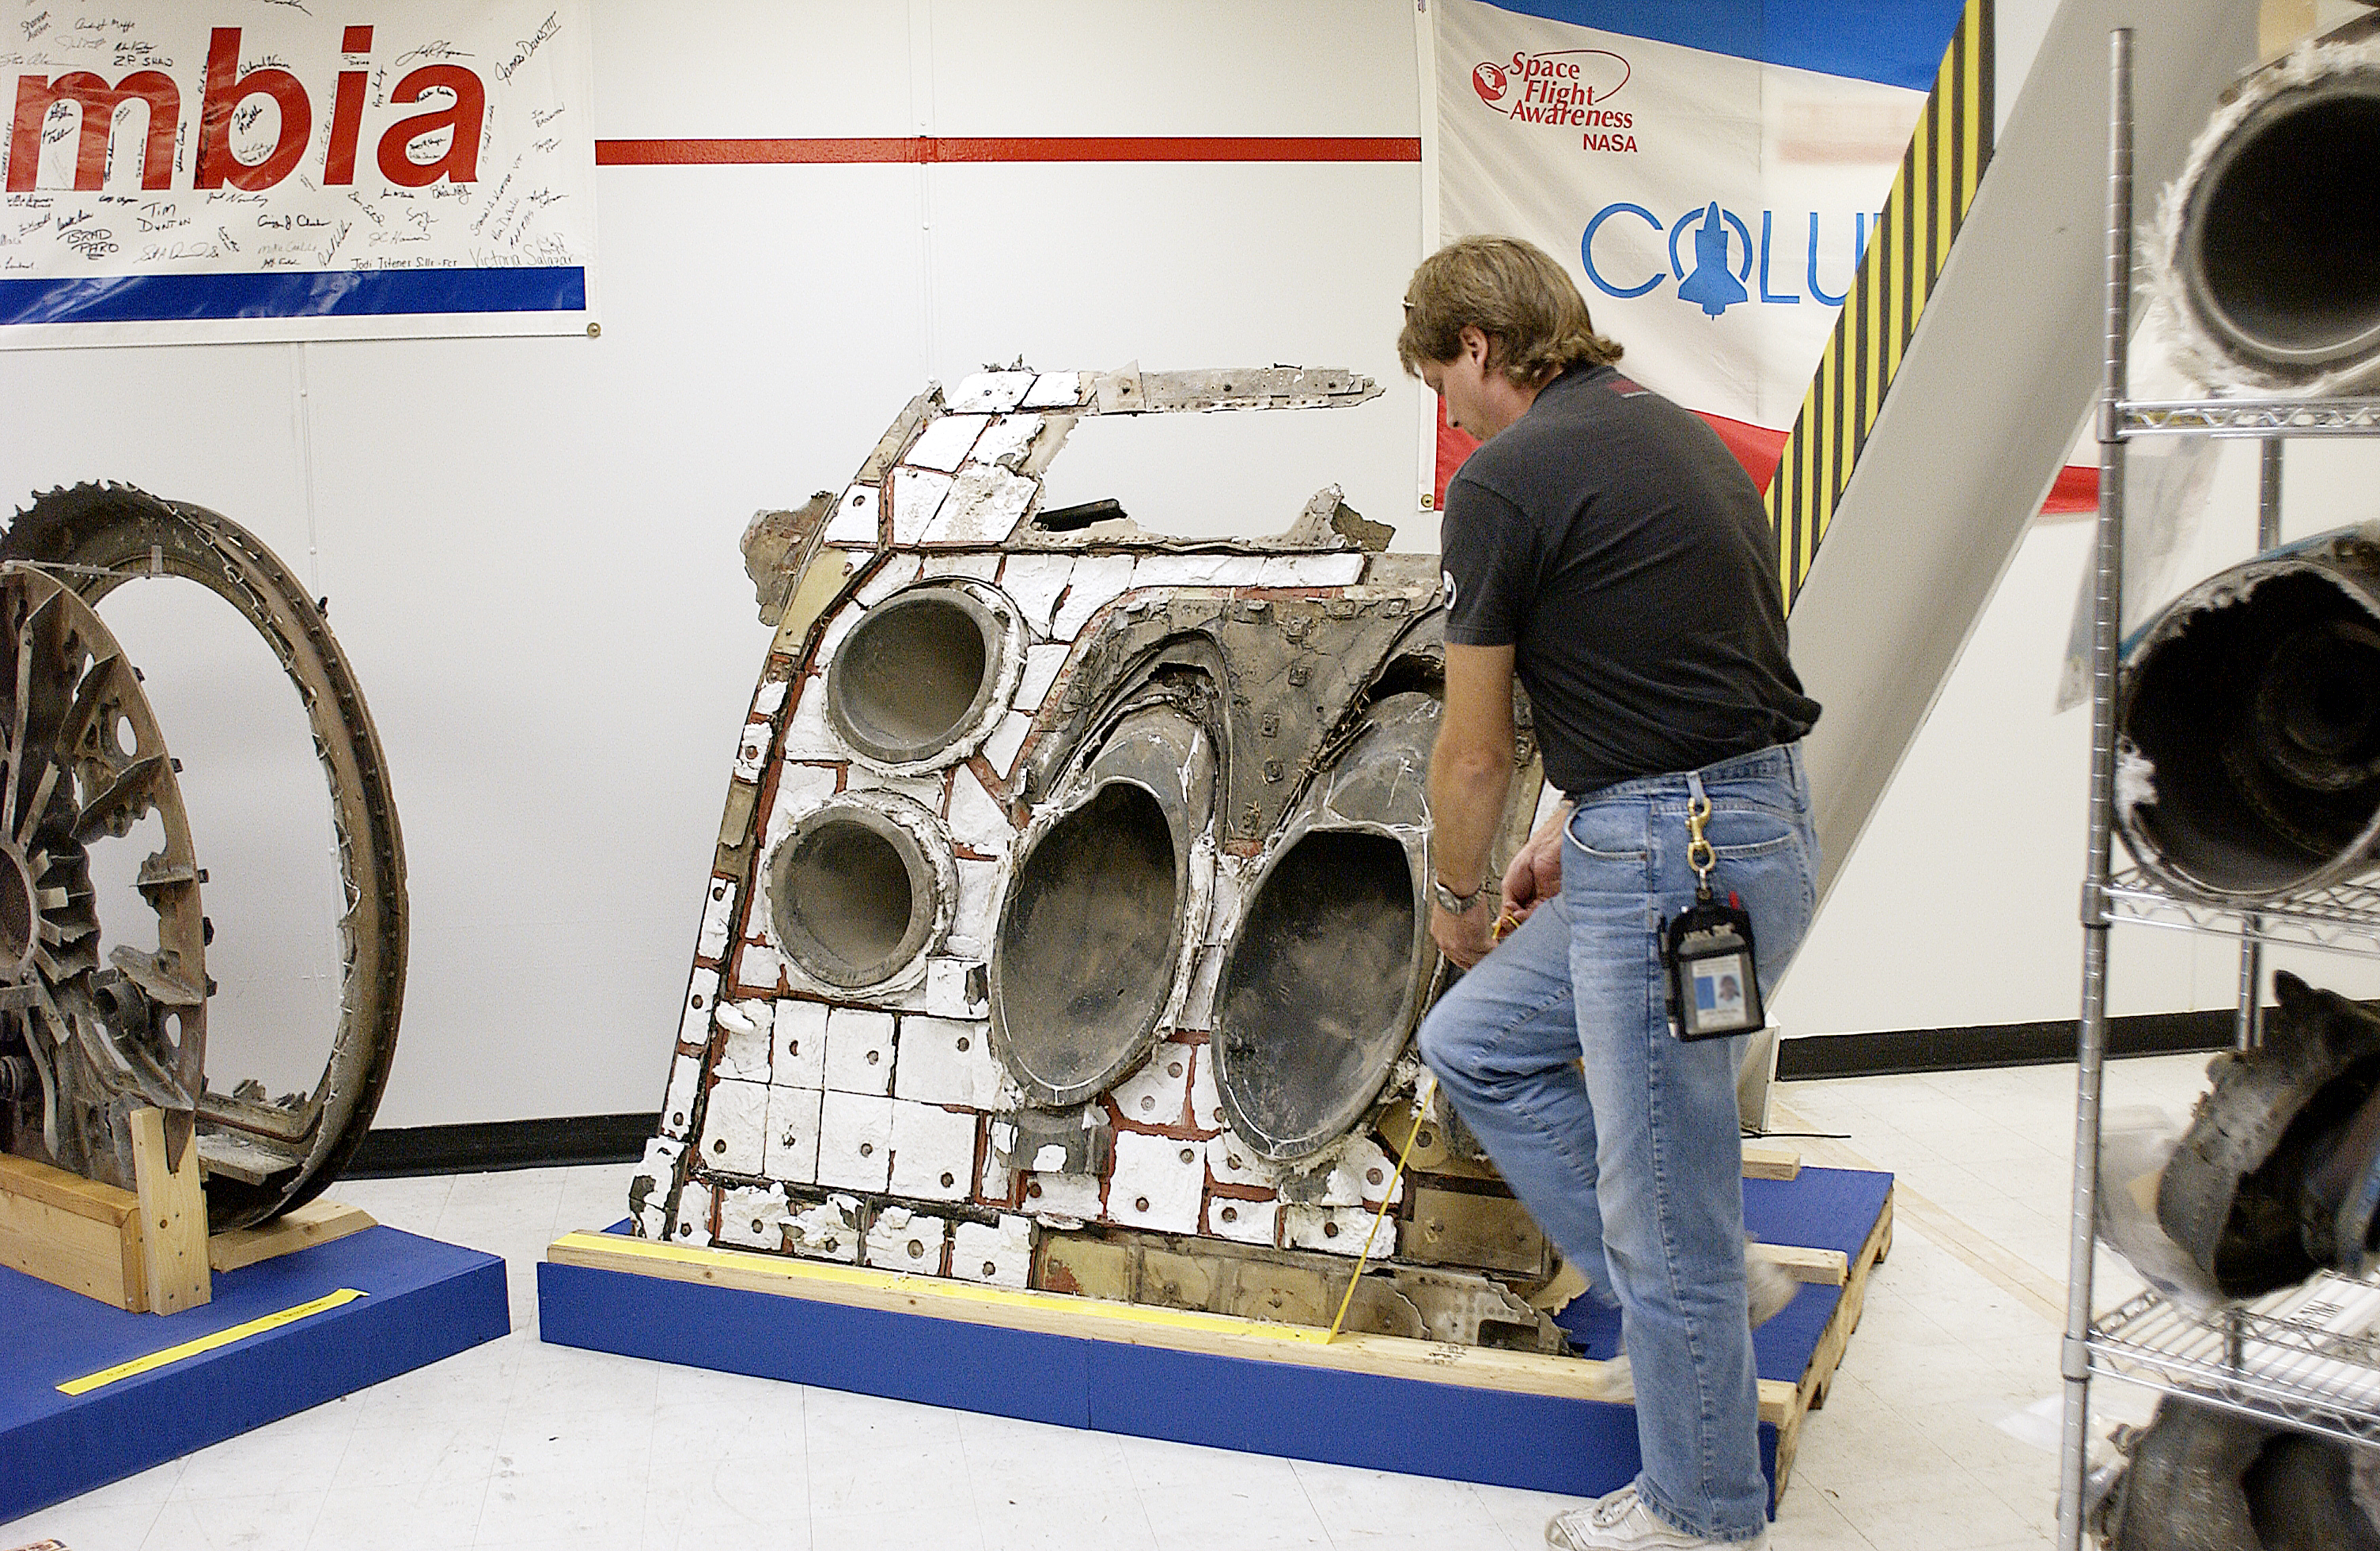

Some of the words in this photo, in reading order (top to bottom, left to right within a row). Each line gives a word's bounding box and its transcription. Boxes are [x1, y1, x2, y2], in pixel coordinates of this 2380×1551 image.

[1510, 51, 1580, 82] Space
[6, 25, 486, 192] mbia
[1525, 80, 1595, 110] Flight
[1510, 100, 1633, 128] Awareness
[1583, 133, 1638, 153] NASA
[1581, 203, 1882, 307] COLU
